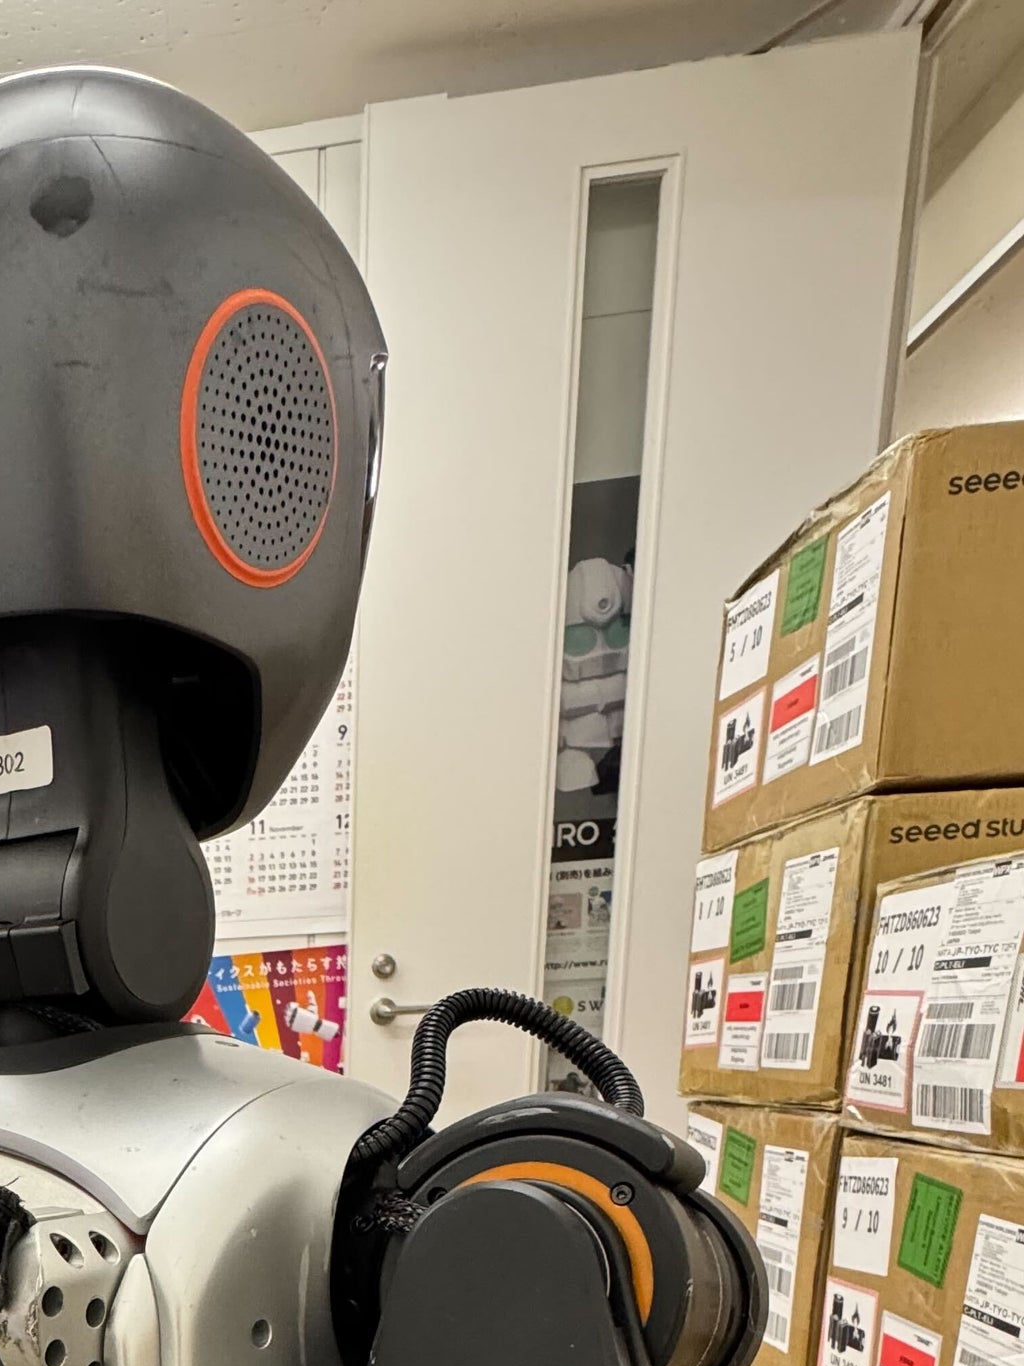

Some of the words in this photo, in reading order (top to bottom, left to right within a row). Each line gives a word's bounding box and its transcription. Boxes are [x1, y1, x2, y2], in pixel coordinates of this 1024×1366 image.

[948, 470, 1024, 496] seee
[752, 625, 762, 650] 10
[338, 724, 348, 740] 9
[250, 820, 265, 834] 11
[889, 819, 981, 844] seeed
[986, 818, 1024, 837] stu
[875, 949, 889, 974] 10
[907, 944, 924, 971] 10
[273, 977, 317, 988] Societies
[859, 1072, 870, 1085] UN
[873, 1074, 891, 1088] 3481
[842, 1208, 847, 1229] 9
[867, 1210, 879, 1234] 10
